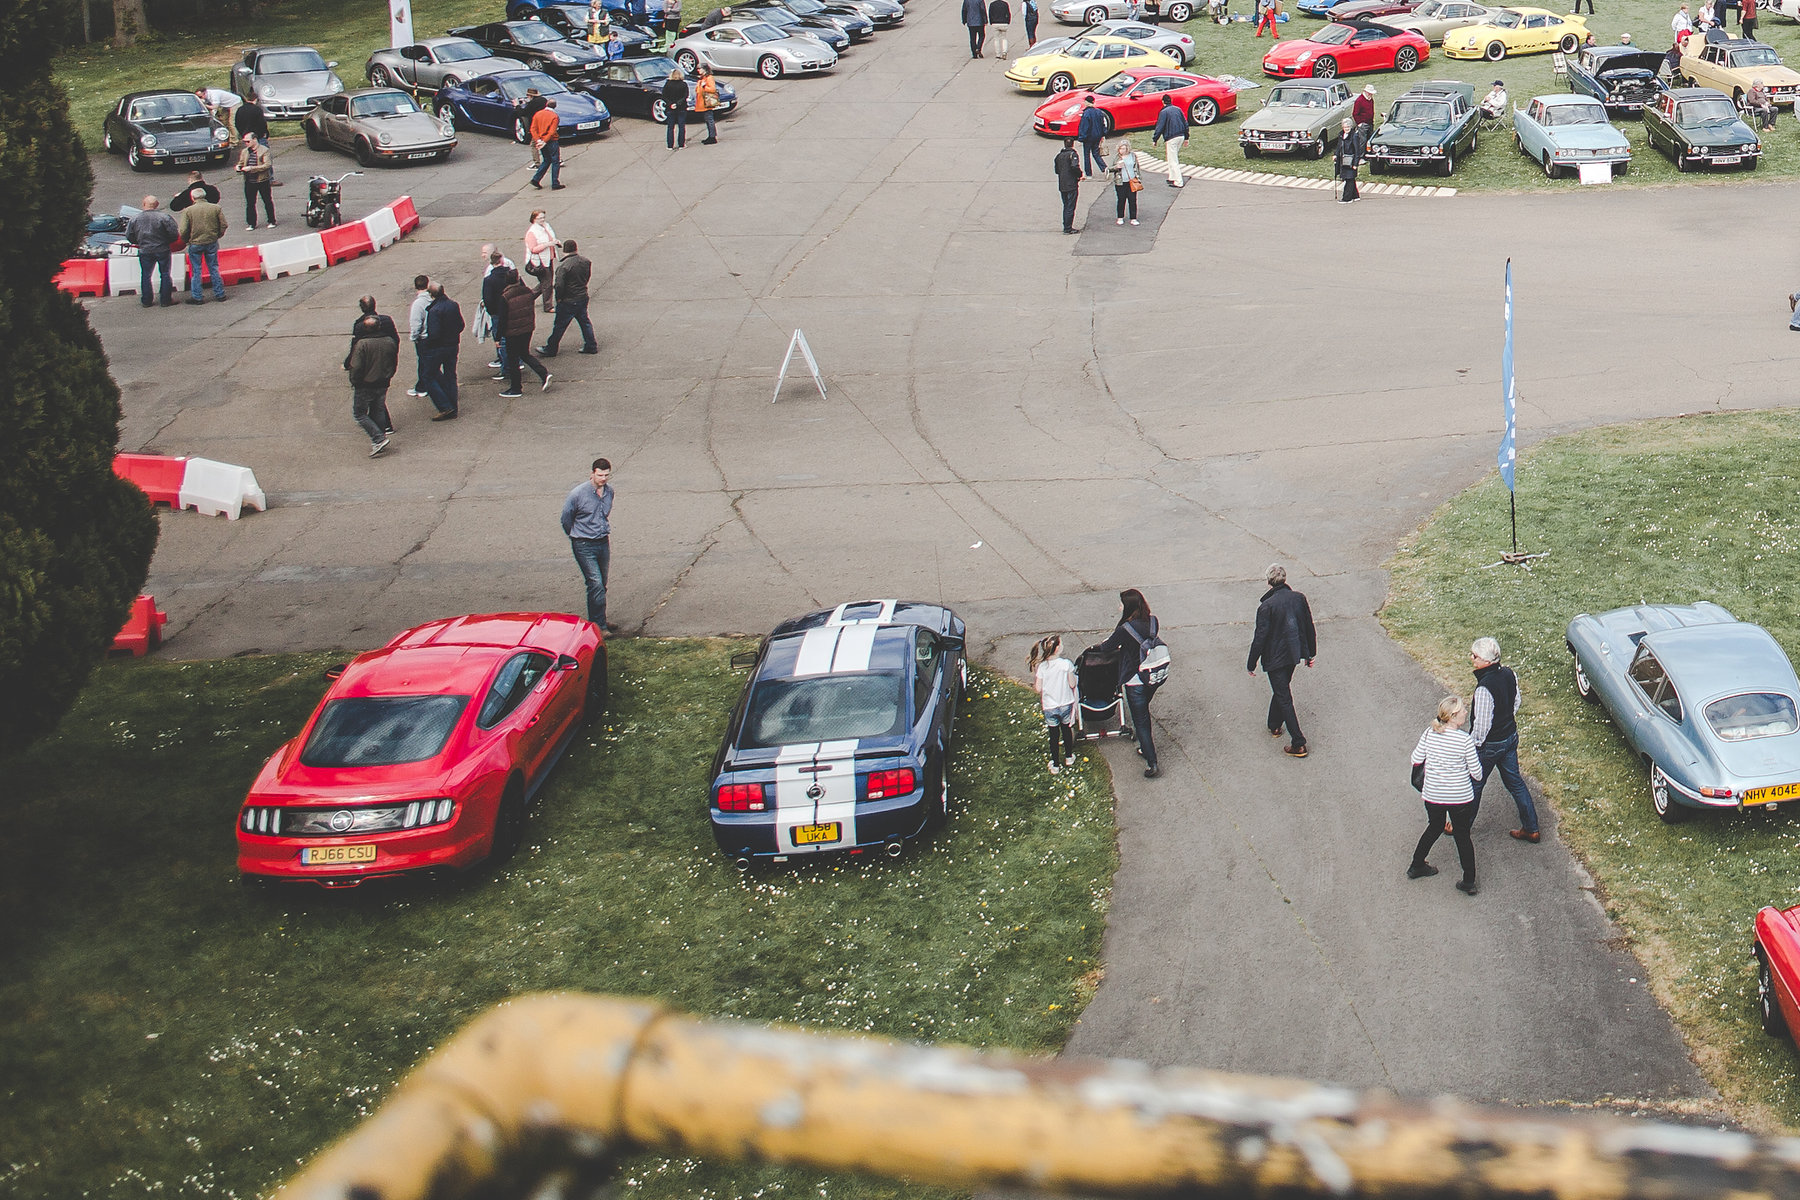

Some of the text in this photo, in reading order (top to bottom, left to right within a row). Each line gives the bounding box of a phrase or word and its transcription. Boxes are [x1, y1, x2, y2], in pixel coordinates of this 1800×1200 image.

[1744, 784, 1798, 801] NHV 404E
[806, 831, 827, 842] UKA
[310, 845, 374, 861] RJ66 CSU
